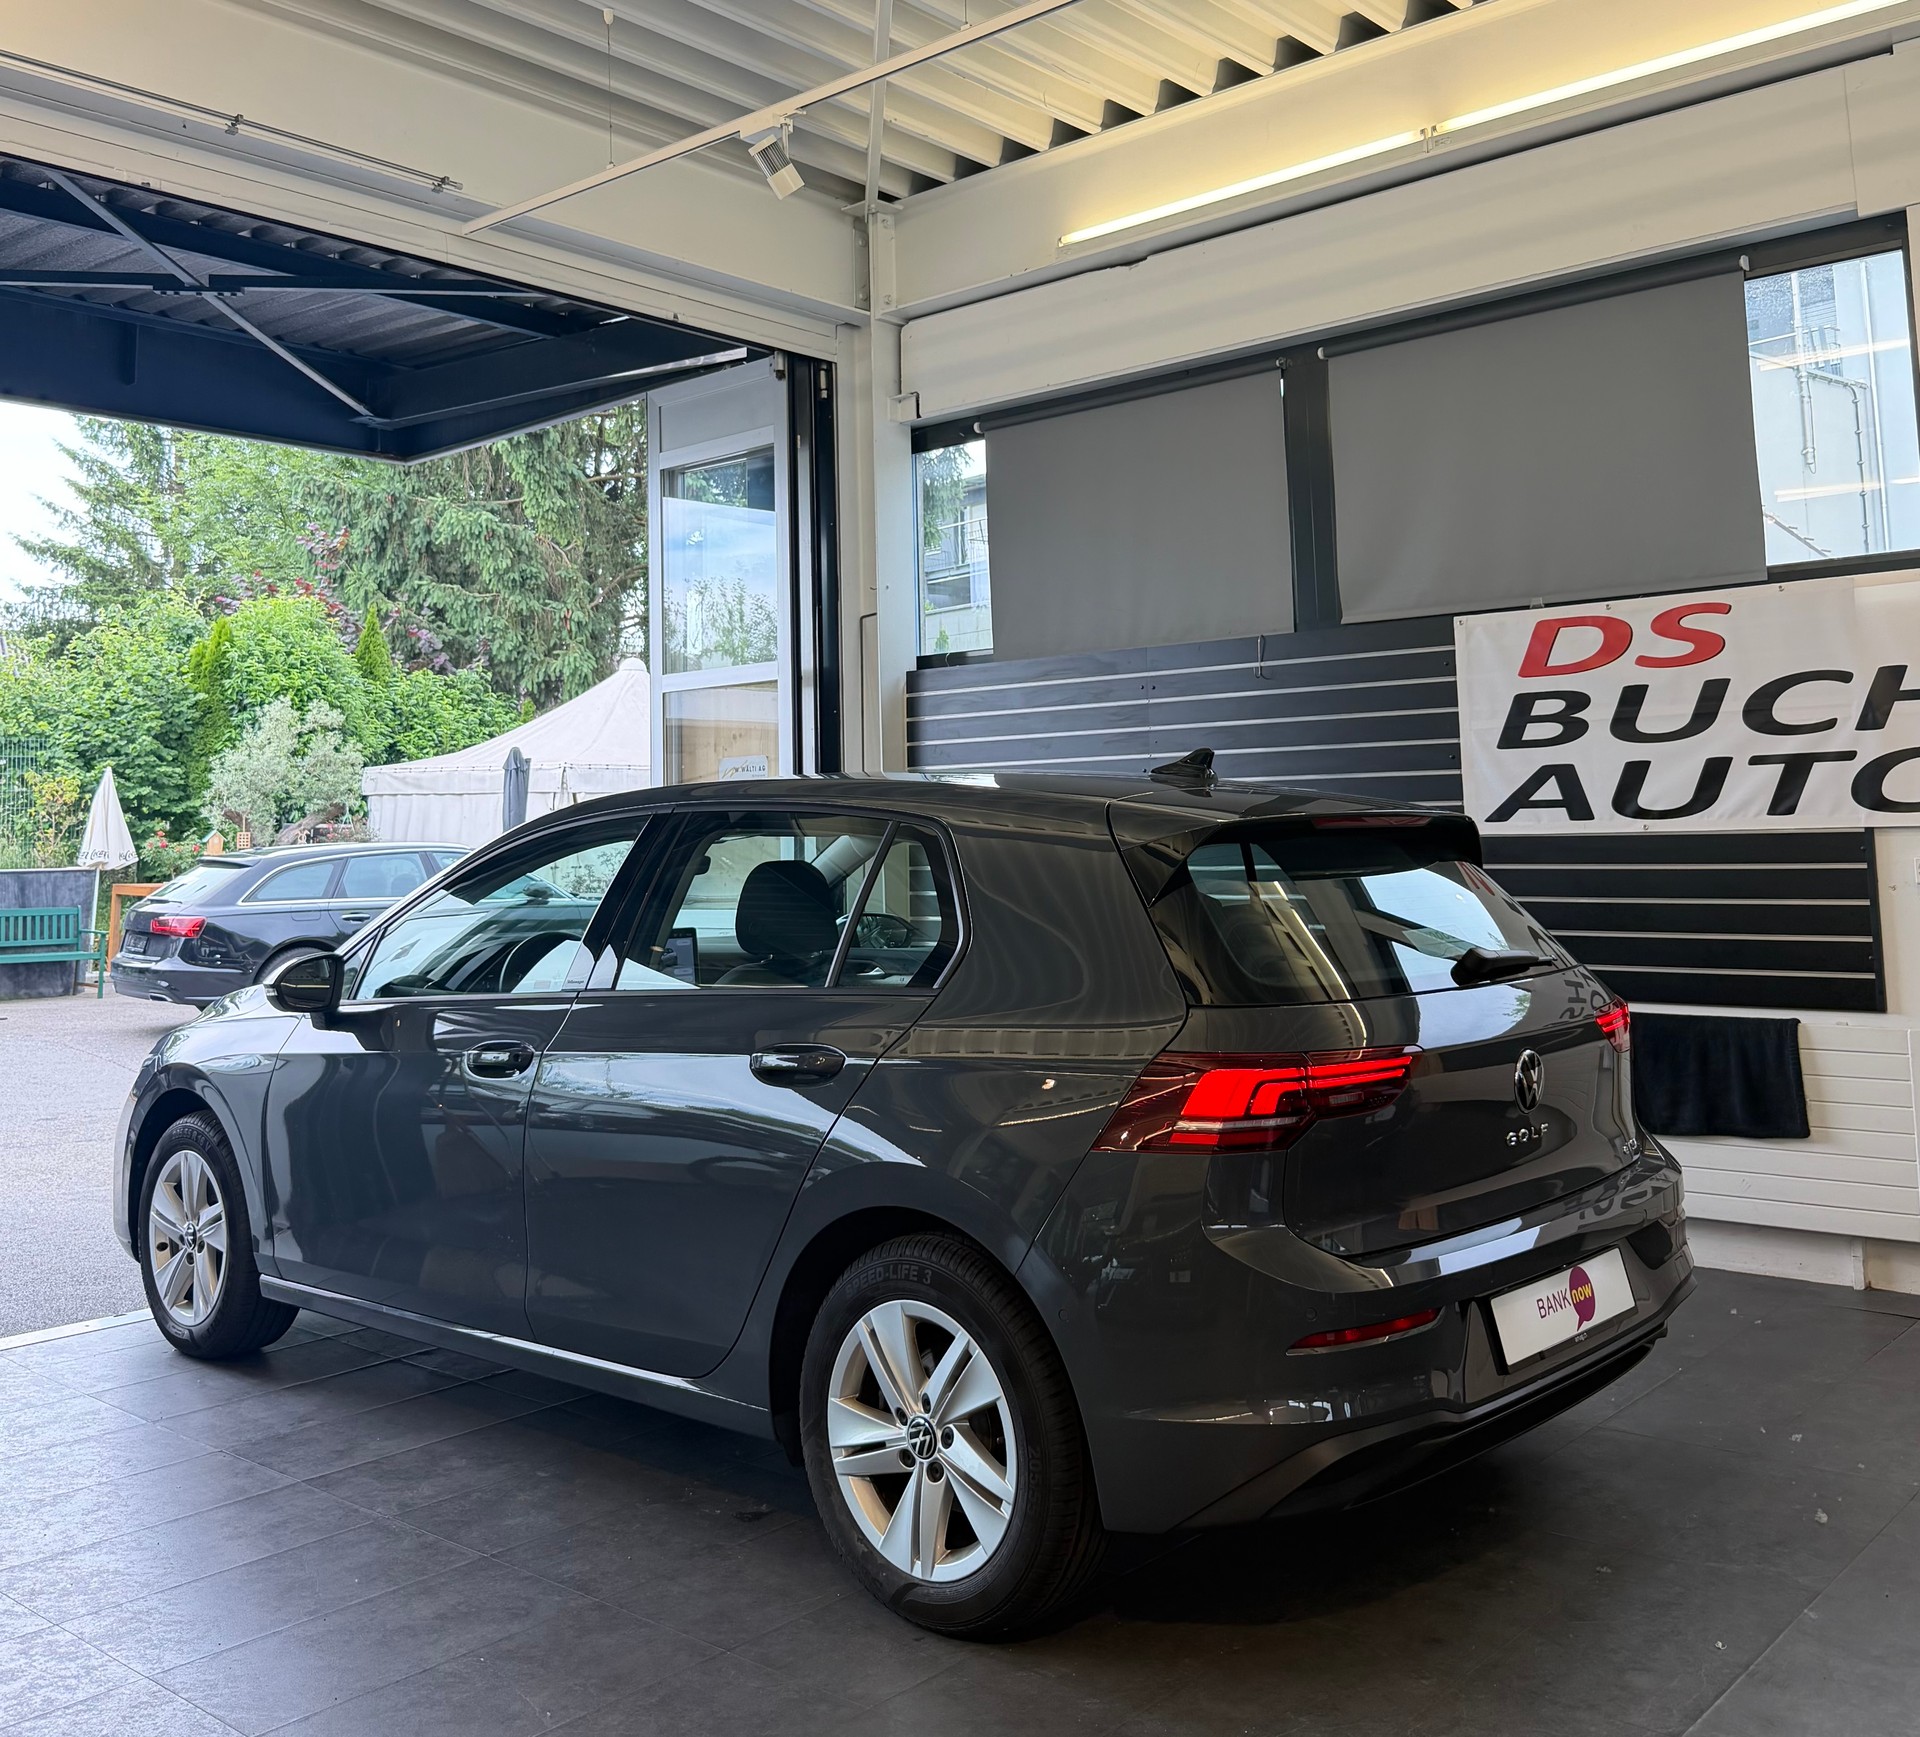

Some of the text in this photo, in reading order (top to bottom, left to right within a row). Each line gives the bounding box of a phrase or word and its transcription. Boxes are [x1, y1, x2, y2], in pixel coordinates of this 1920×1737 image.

[1518, 602, 1732, 678] DS
[1506, 1123, 1549, 1146] GOLF
[922, 1269, 932, 1285] 3
[1536, 1282, 1592, 1319] BANK now
